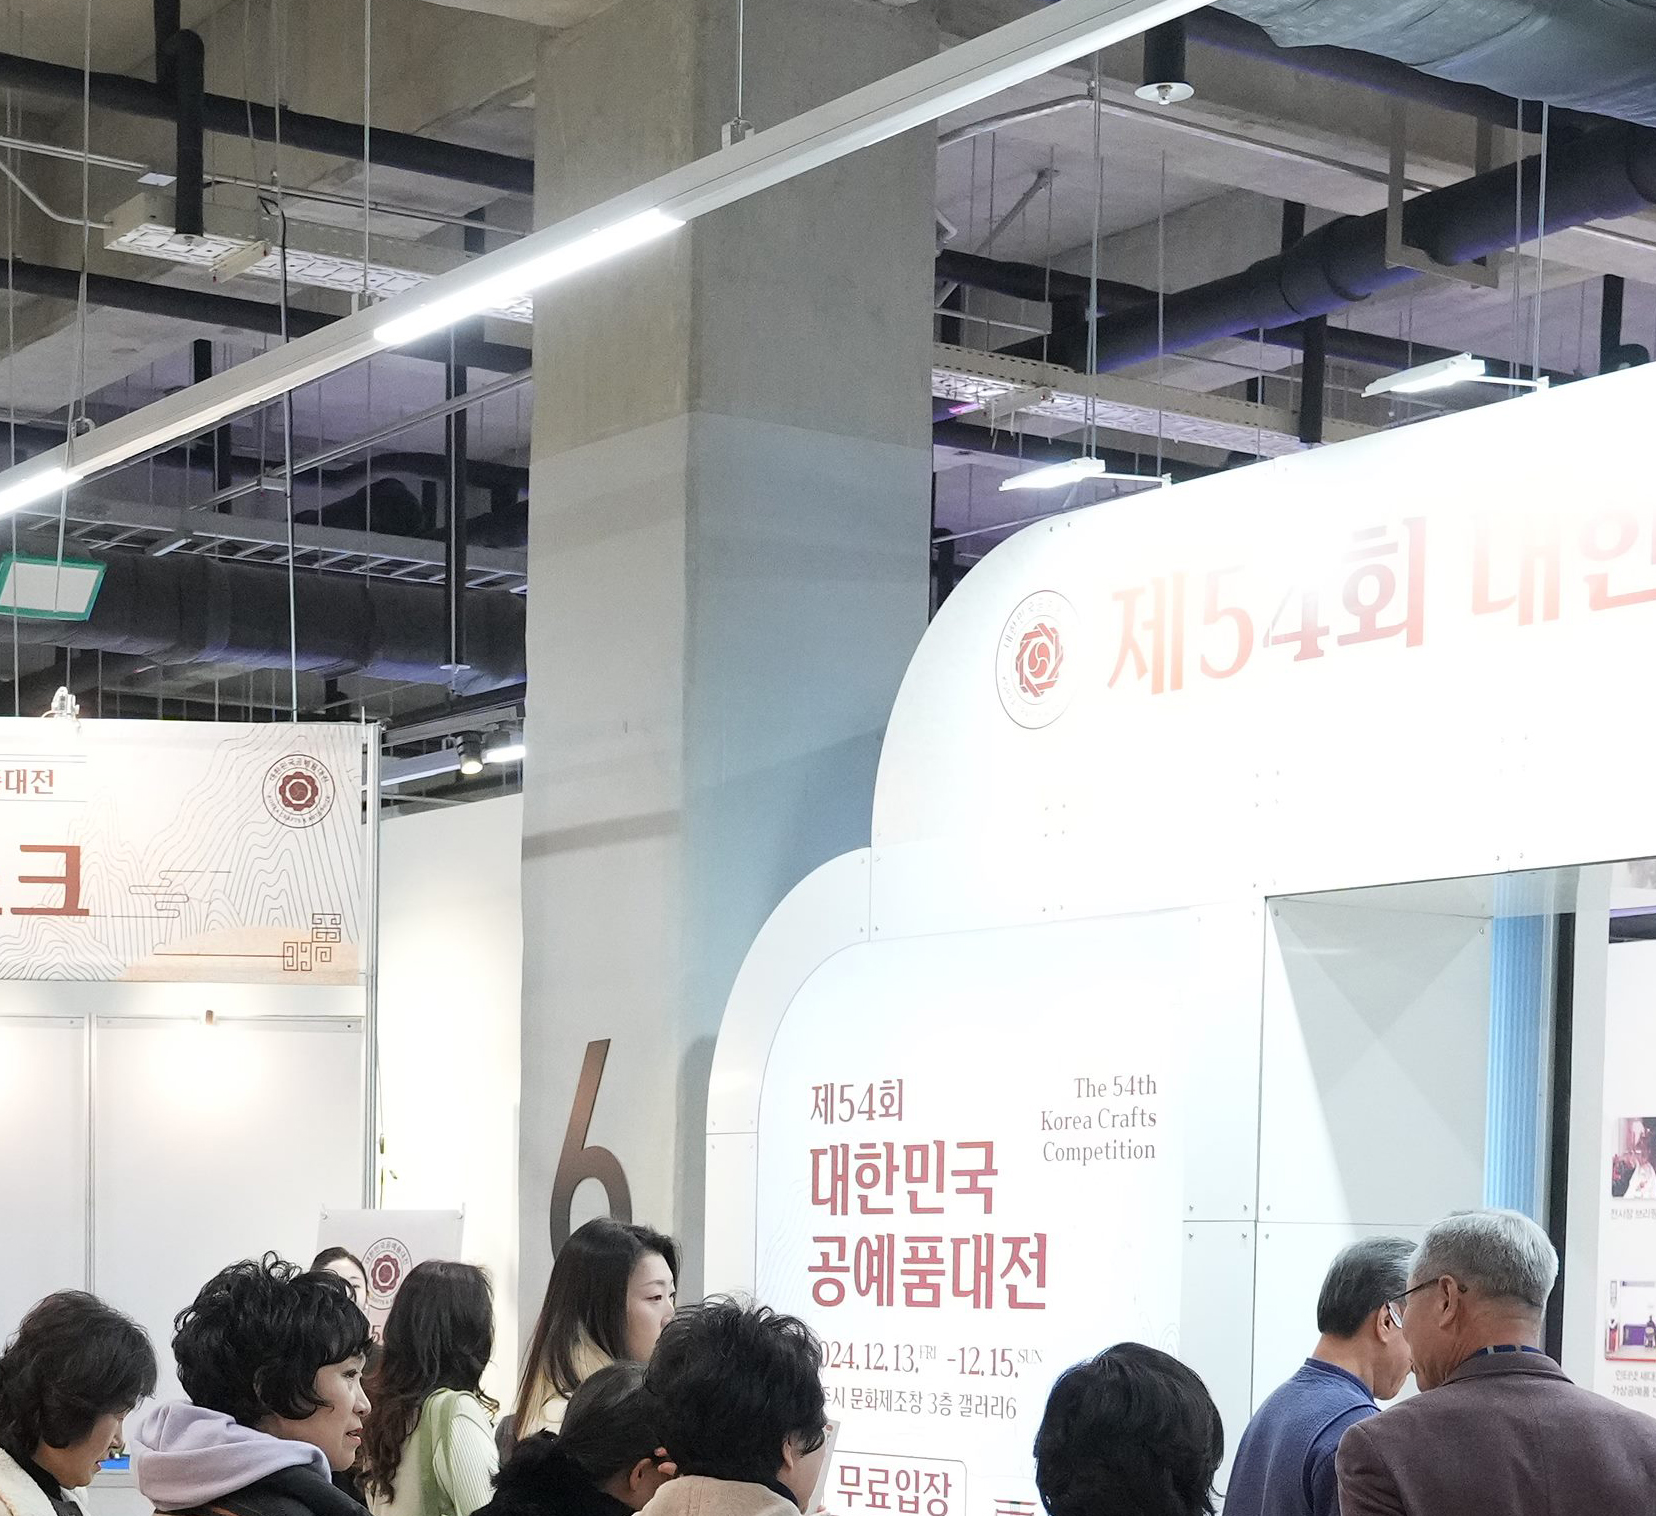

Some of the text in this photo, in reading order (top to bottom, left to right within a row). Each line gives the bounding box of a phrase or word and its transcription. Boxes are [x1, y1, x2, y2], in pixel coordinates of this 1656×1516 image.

[1106, 514, 1426, 695] 제54회
[809, 1078, 905, 1125] 제54회
[1074, 1074, 1157, 1098] The 54th
[1041, 1105, 1157, 1131] Korea Crafts
[549, 1038, 633, 1260] 6
[1043, 1138, 1156, 1166] Competition
[809, 1139, 999, 1216] 대한민국
[807, 1232, 1048, 1311] 공예품대전
[820, 1340, 920, 1374] 024.12.13.
[919, 1345, 937, 1360] FRI
[1017, 1349, 1043, 1364] SUN
[850, 1387, 923, 1416] 문화제조창
[929, 1392, 953, 1417] 3층
[959, 1393, 1017, 1420] 갤러리6
